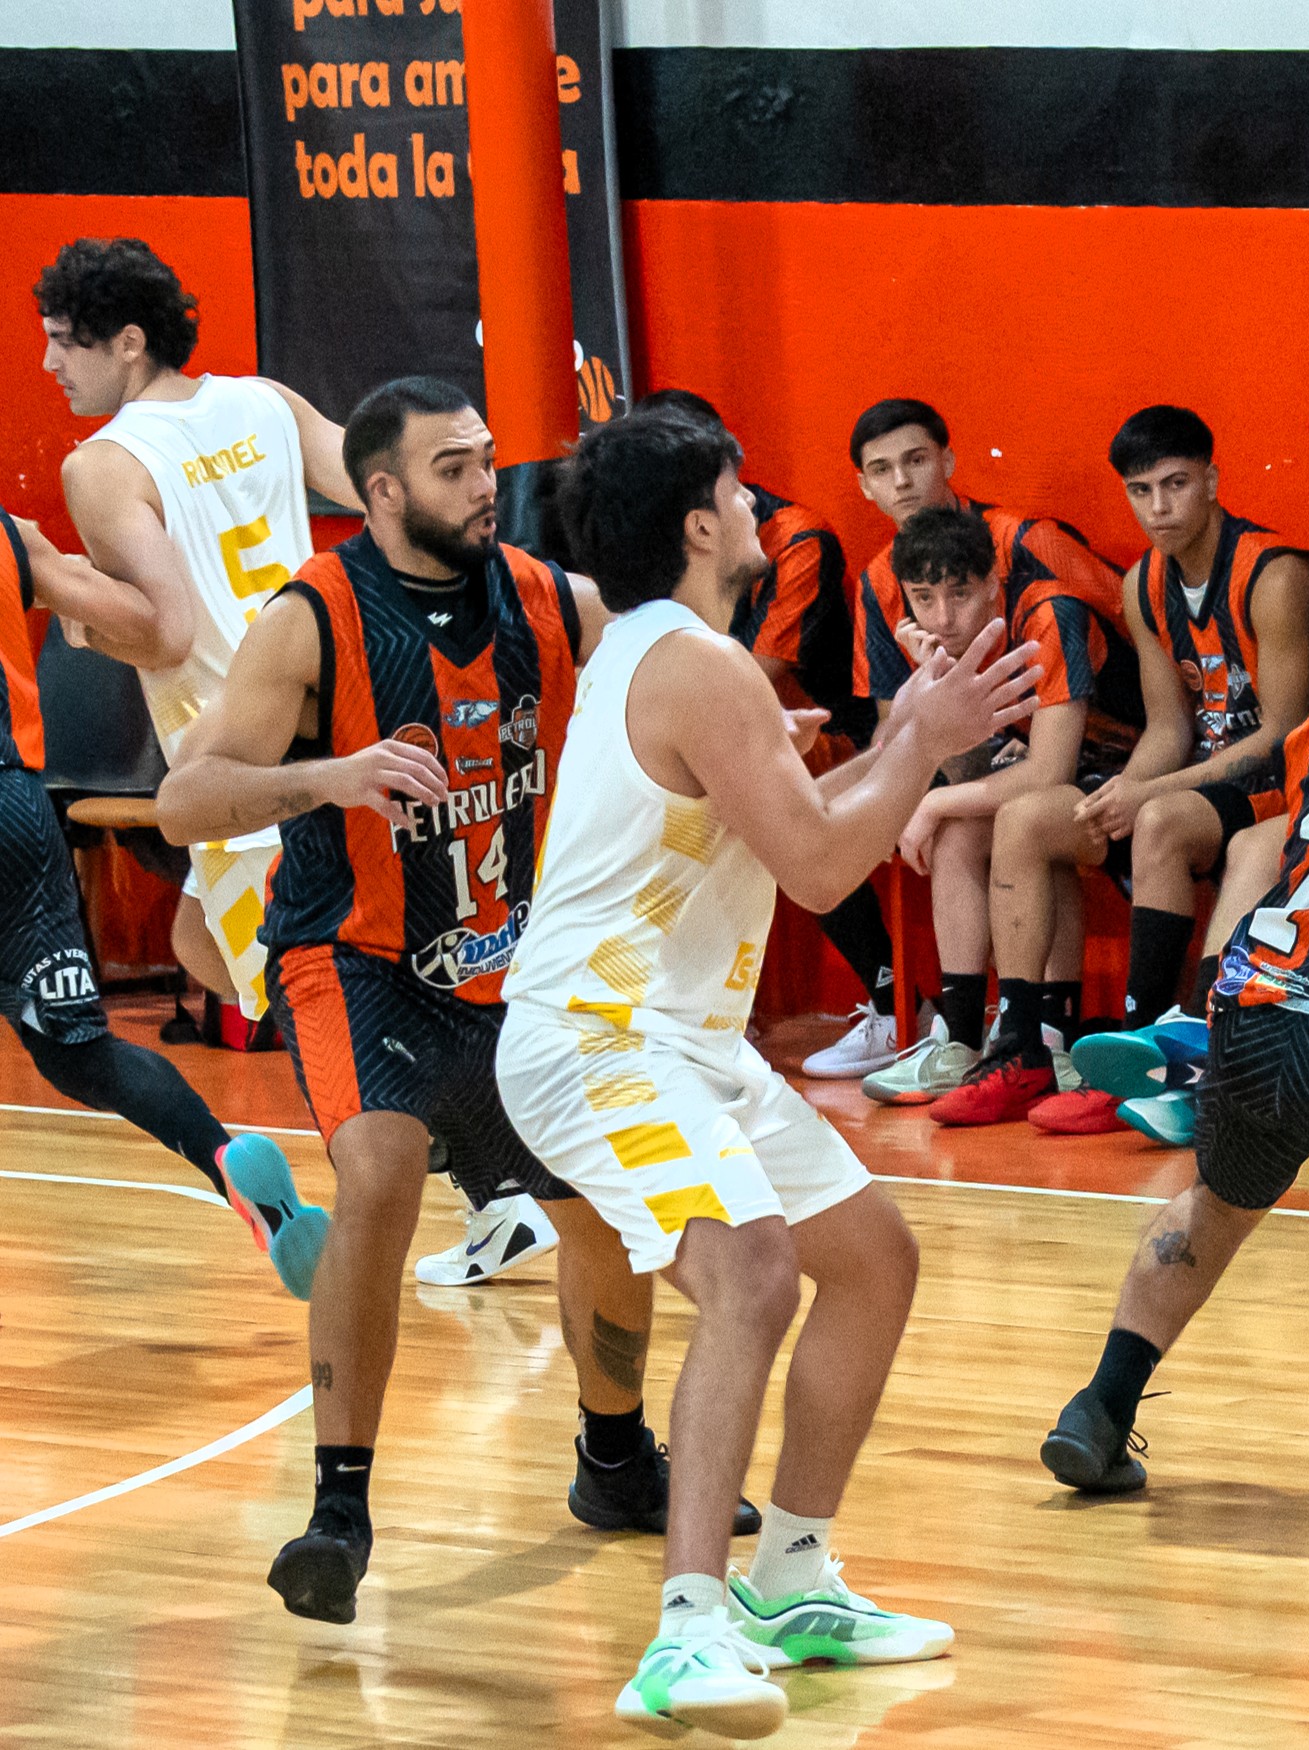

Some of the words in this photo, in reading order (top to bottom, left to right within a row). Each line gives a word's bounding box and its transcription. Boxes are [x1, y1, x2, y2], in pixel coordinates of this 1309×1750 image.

[281, 60, 391, 122] para
[295, 132, 398, 199] toda
[411, 132, 455, 198] la
[218, 514, 292, 627] 5
[448, 823, 509, 922] 14
[39, 966, 96, 1000] LITA
[53, 950, 62, 961] Y
